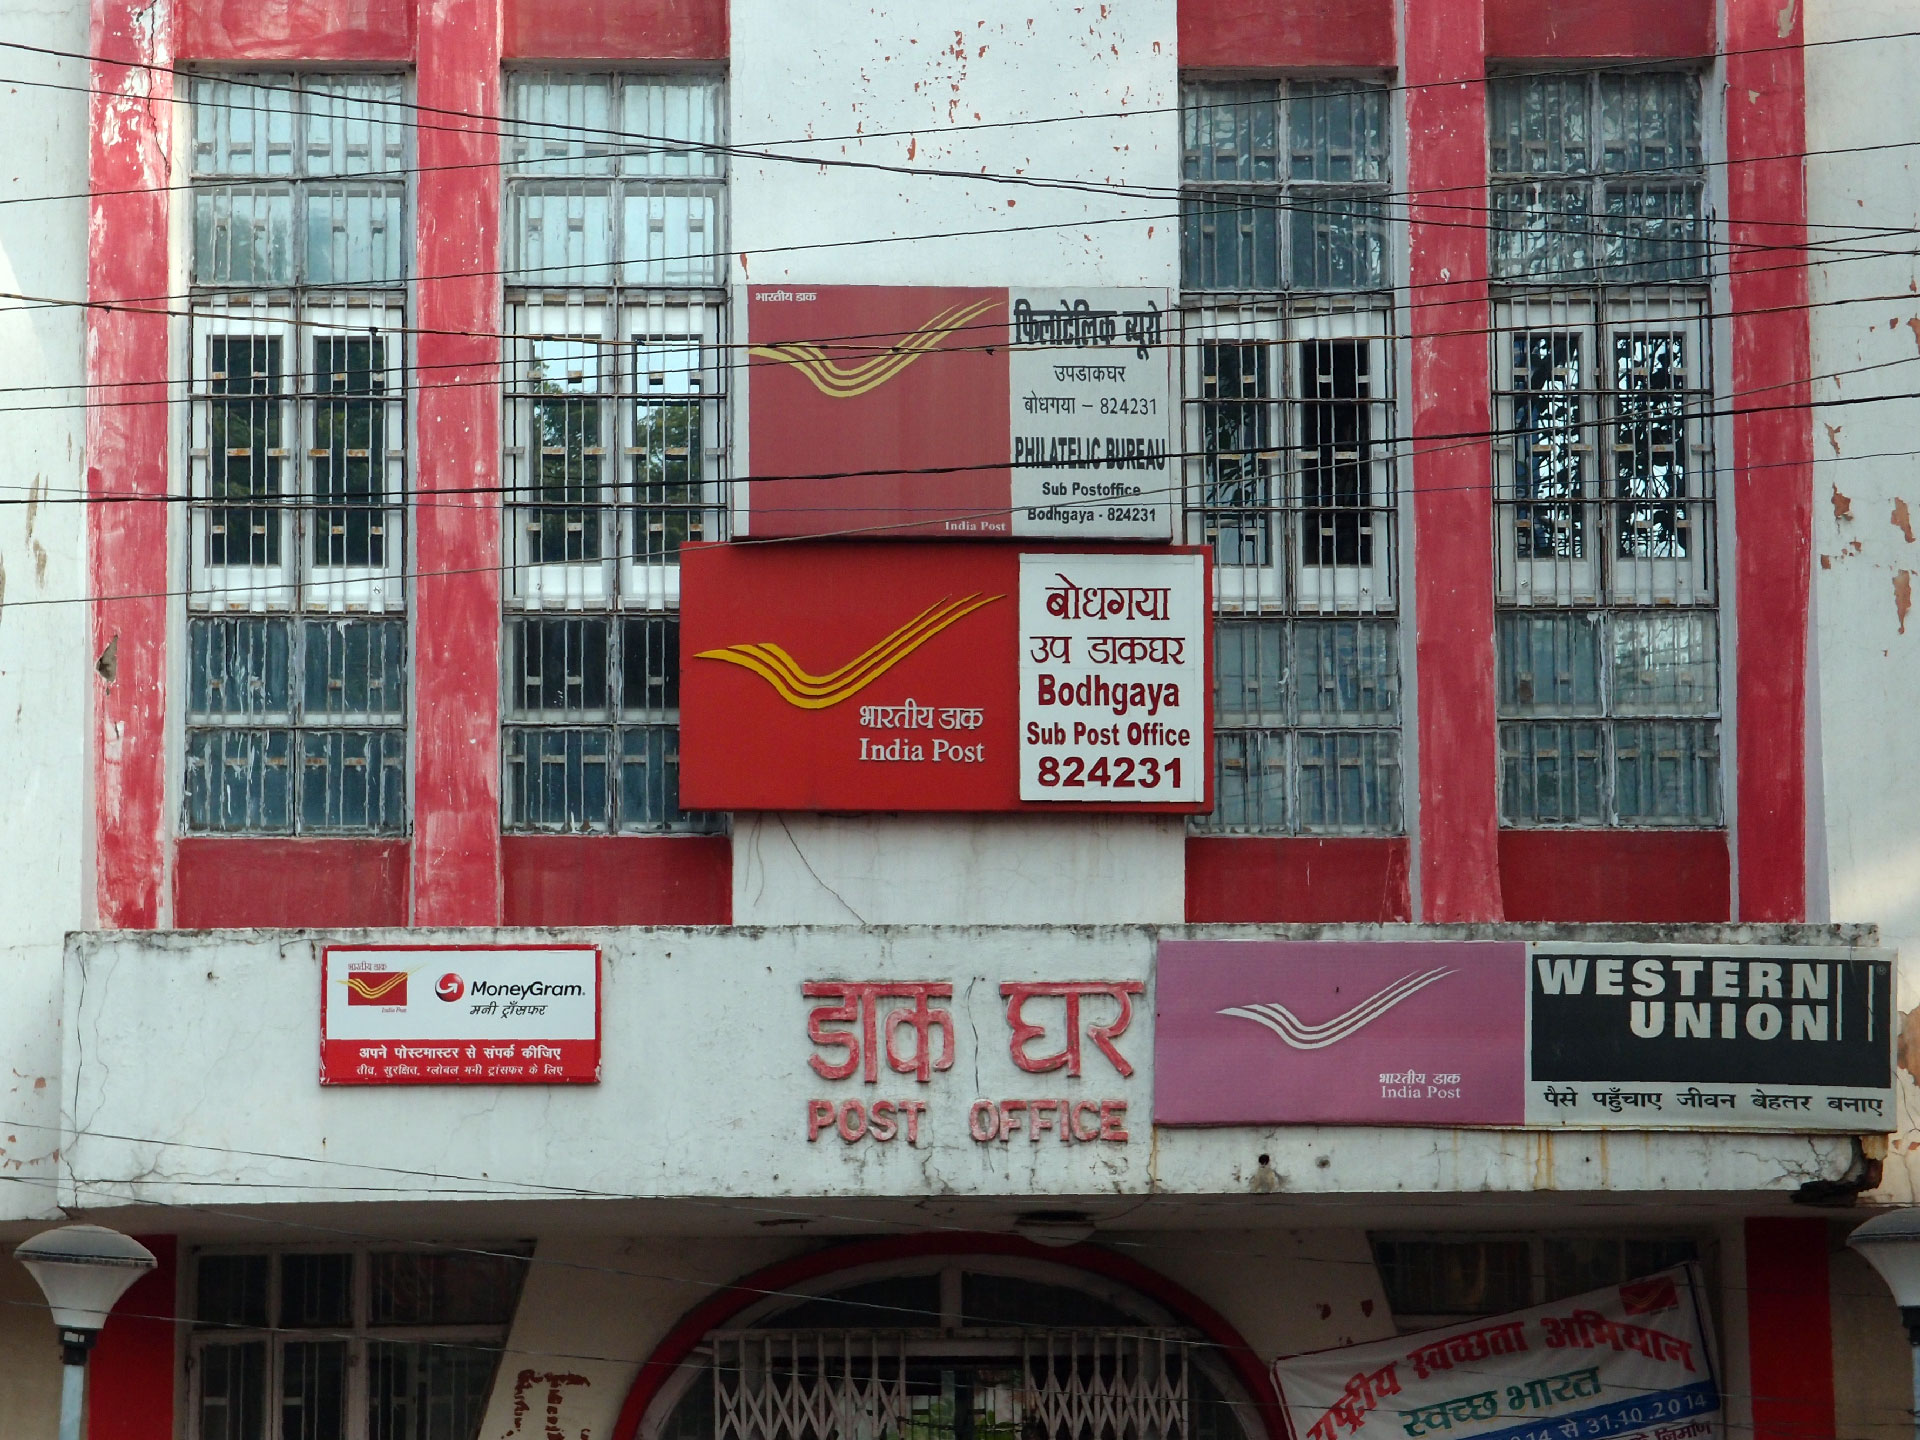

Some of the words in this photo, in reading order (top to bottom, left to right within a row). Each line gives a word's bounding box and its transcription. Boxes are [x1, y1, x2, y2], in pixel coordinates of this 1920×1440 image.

[755, 290, 792, 301] भारतीय
[796, 292, 817, 301] डाक
[1054, 365, 1126, 383] उपडाकघर
[1023, 391, 1075, 415] बोधगया
[1100, 397, 1157, 415] 824231
[1015, 437, 1100, 469] PHILATELIC
[1106, 438, 1165, 470] BUREAU
[1043, 482, 1067, 495] Sub
[1072, 482, 1141, 496] Postoffice
[945, 521, 976, 531] India
[980, 522, 1006, 531] Post
[1028, 507, 1094, 523] Bodhgaya
[1108, 508, 1155, 521] 824231
[1045, 573, 1170, 620] बोधगया
[1030, 636, 1071, 664] उप
[1088, 636, 1185, 665] डाकघर
[1038, 674, 1180, 715] Bodhgaya
[859, 698, 934, 729] भारतीय
[939, 708, 983, 729] डाक
[1027, 721, 1066, 746] Sub
[1074, 722, 1119, 746] Post
[1128, 722, 1190, 746] Office
[859, 738, 924, 762] India
[932, 740, 985, 762] Post
[1038, 757, 1181, 788] 824231
[1537, 959, 1829, 999] WESTERN
[470, 1001, 498, 1015] मनी
[1629, 1001, 1829, 1041] UNION
[803, 980, 955, 1083] डाक
[1000, 980, 1144, 1077] घर
[360, 1045, 387, 1058] अपने
[395, 1044, 459, 1059] पोस्टमास्टर
[466, 1045, 476, 1058] से
[484, 1044, 515, 1058] संपर्क
[522, 1045, 561, 1059] कीजिए
[465, 1064, 481, 1074] मनी
[529, 1064, 538, 1074] के
[544, 1064, 563, 1076] लिए
[1379, 1069, 1425, 1084] भारतीय
[1433, 1074, 1461, 1084] डाक
[1382, 1085, 1421, 1098] India
[1427, 1086, 1460, 1098] Post
[1544, 1086, 1577, 1107] पैसे
[1593, 1088, 1662, 1112] पहुँचाए
[1676, 1087, 1736, 1108] जीवन
[1751, 1089, 1812, 1110] बेहतर
[1828, 1097, 1883, 1116] बनाए
[808, 1099, 926, 1143] POST
[969, 1098, 1128, 1142] OFFICE
[1407, 1321, 1528, 1378] स्वच्छता
[1540, 1309, 1697, 1372] अभियान
[1399, 1389, 1499, 1436] स्वच्छ
[1507, 1366, 1602, 1411] भारत
